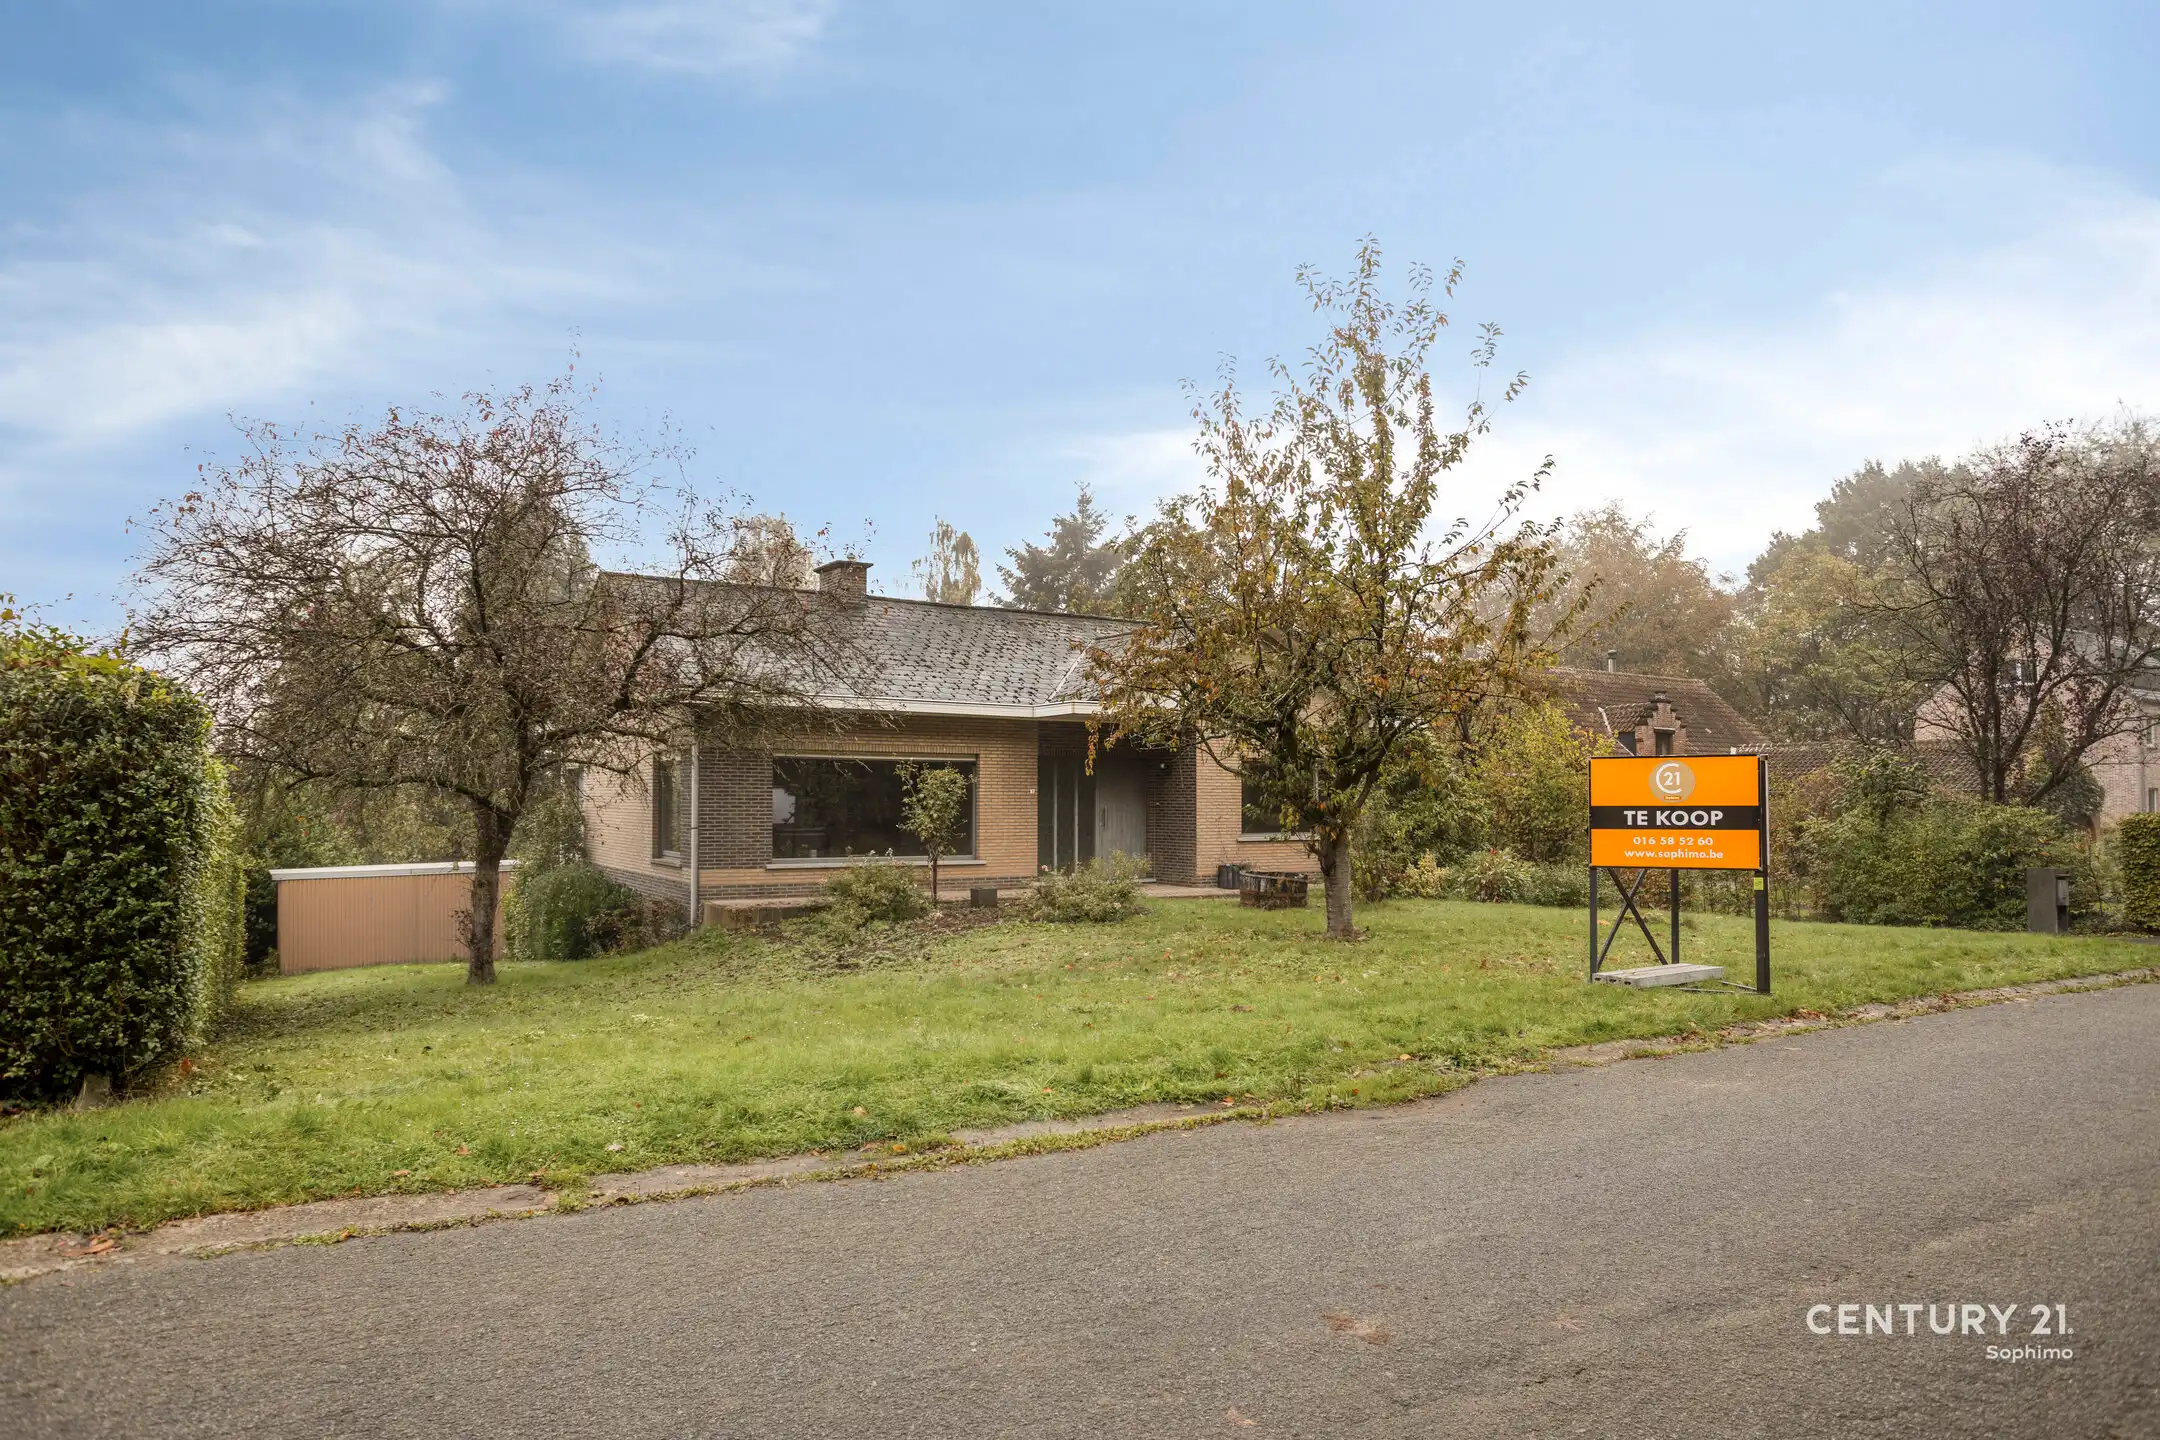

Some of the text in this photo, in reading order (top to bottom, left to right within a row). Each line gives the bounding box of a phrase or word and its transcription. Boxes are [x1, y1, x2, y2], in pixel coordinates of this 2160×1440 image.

[1663, 771, 1681, 786] 21
[1623, 810, 1724, 826] TE KOOP
[1633, 836, 1714, 846] 016 58 52 60
